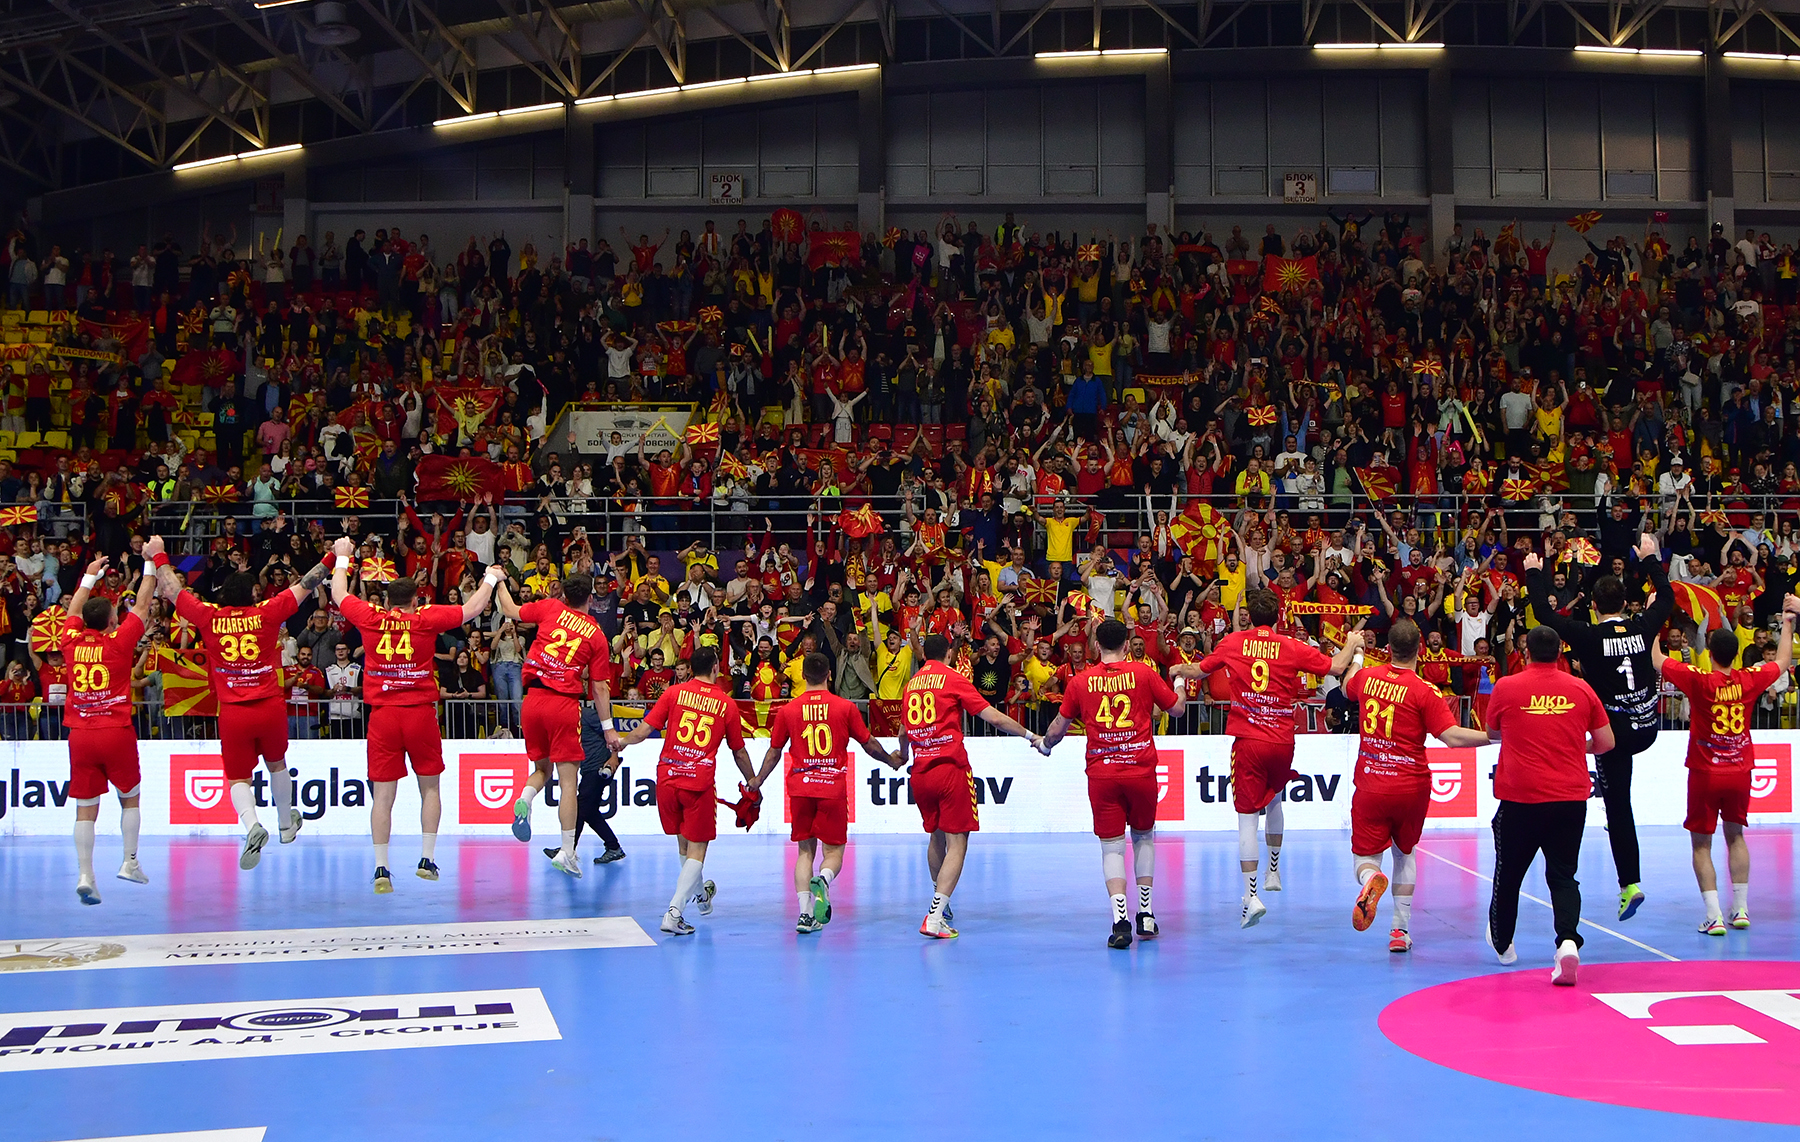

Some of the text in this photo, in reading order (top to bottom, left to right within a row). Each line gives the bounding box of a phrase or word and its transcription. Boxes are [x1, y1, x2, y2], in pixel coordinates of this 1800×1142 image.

[713, 175, 740, 183] БЛОК
[721, 183, 732, 198] 2
[1295, 181, 1305, 196] 3
[58, 347, 110, 360] MACEDONIA
[1148, 375, 1199, 385] MACEDOIA
[556, 609, 597, 639] PETKOVSKI
[73, 645, 104, 663] NIKOLOV
[219, 633, 261, 662] 36
[375, 630, 415, 662] 44
[549, 628, 582, 664] 21
[1242, 638, 1281, 660] GJORGIEV
[1602, 634, 1646, 657] MITREVSKI
[73, 663, 110, 693] 30
[1088, 671, 1136, 693] STOJKOVIKJ
[1251, 658, 1270, 693] 9
[1616, 656, 1635, 690] 1
[1363, 676, 1408, 704] RISTEVSKI
[1530, 695, 1568, 708] MKD
[802, 703, 829, 721] MITEV
[907, 691, 937, 725] 88
[1095, 693, 1135, 730] 42
[1363, 697, 1395, 739] 31
[1711, 702, 1745, 735] 38
[676, 709, 715, 748] 55
[801, 723, 833, 757] 10
[867, 766, 1014, 805] triav
[166, 948, 338, 959] Ministry
[402, 941, 506, 950] Sport
[177, 940, 292, 949] Republic
[350, 934, 431, 943] North
[444, 929, 588, 939] Macedonia
[330, 1020, 520, 1038] СКОПЈЕ
